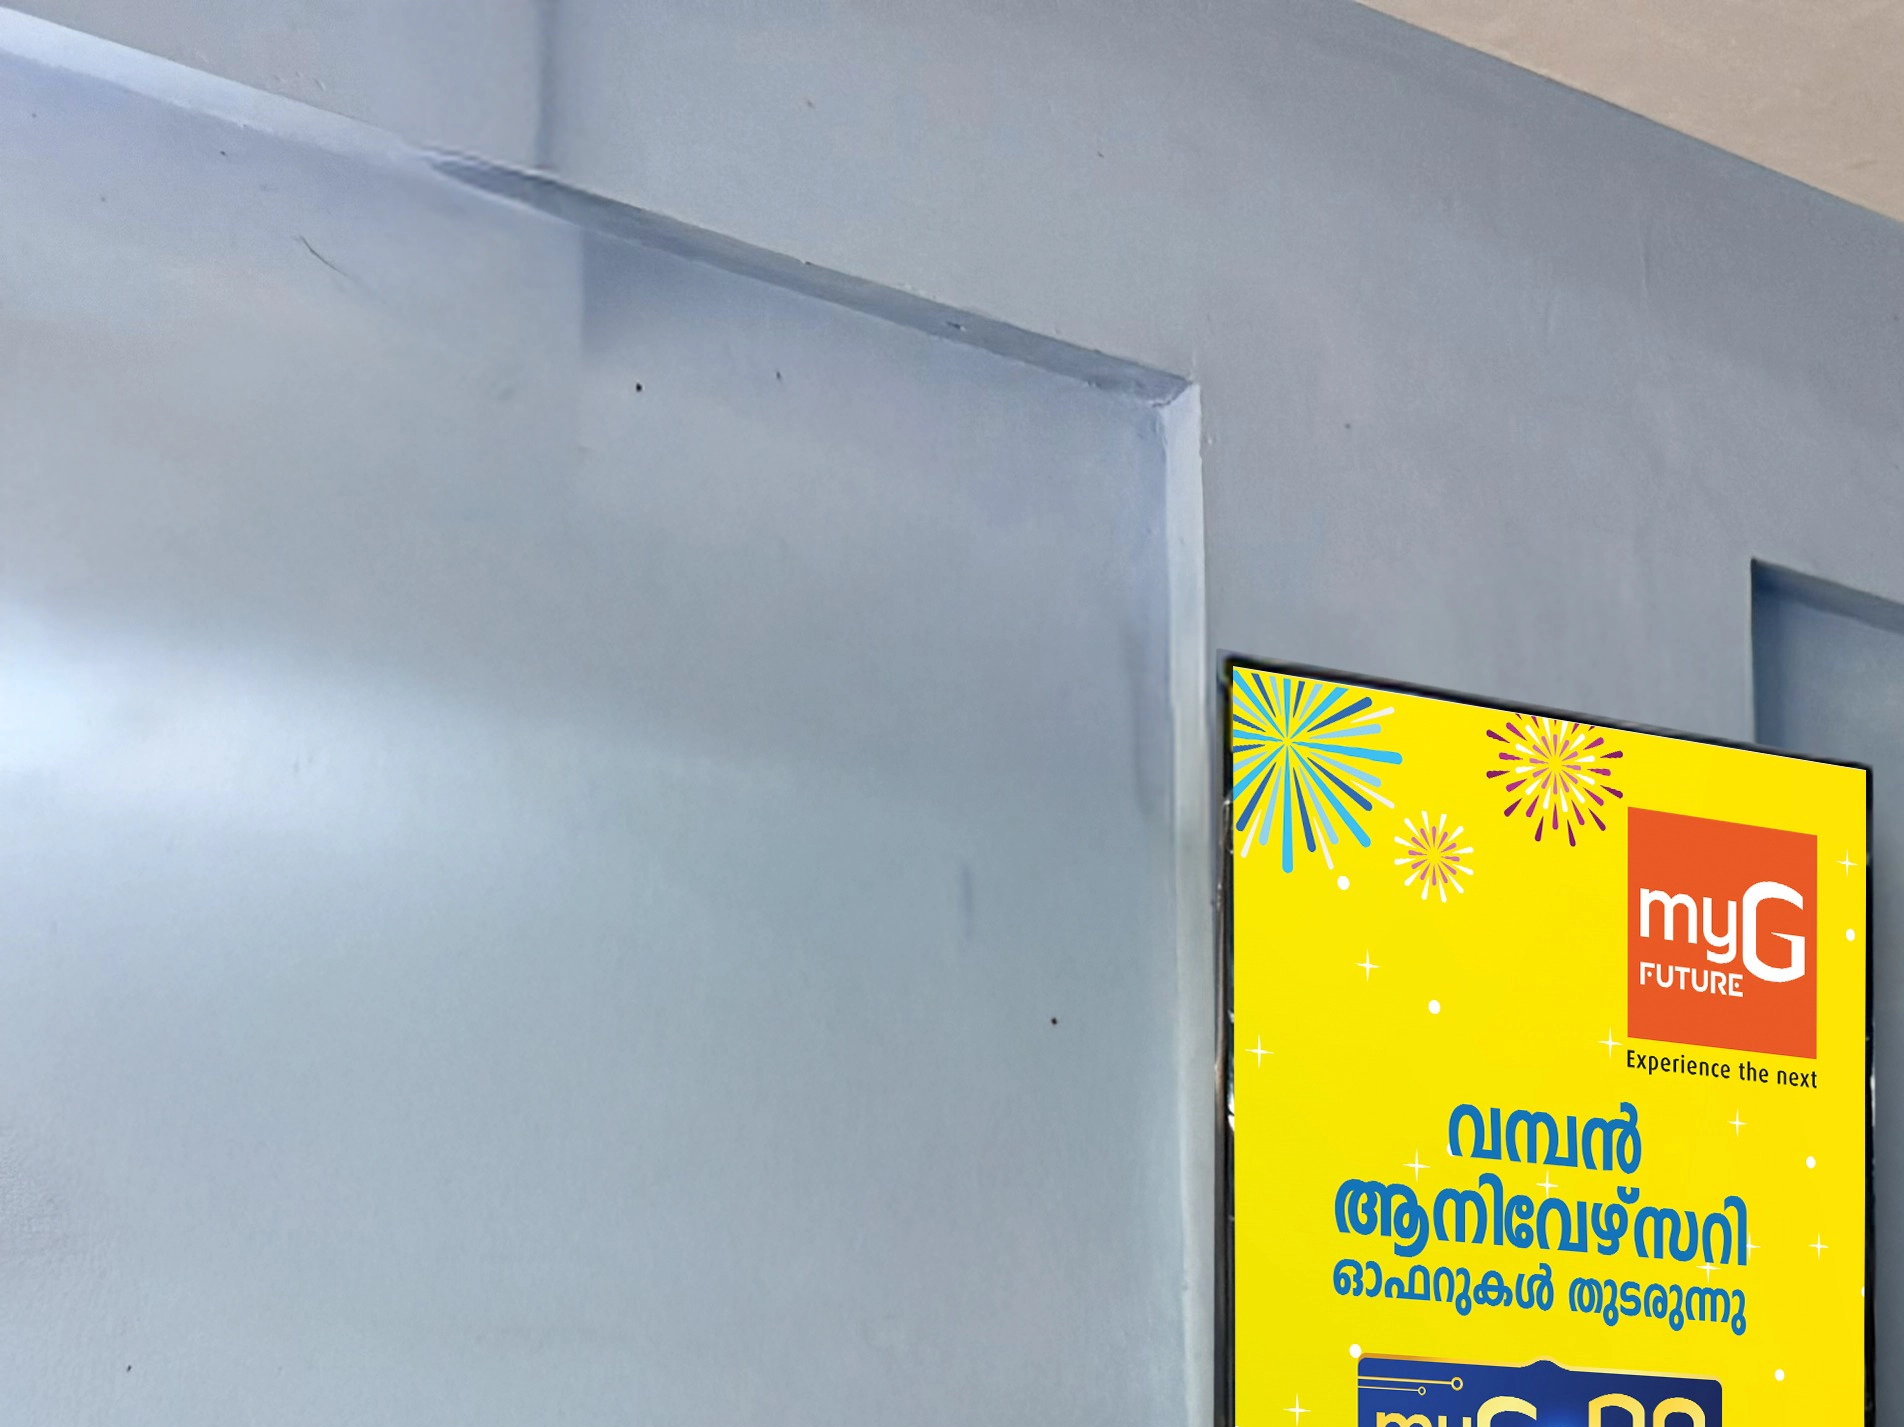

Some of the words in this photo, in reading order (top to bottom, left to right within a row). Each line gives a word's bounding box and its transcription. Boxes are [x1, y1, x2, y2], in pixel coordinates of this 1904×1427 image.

[1640, 882, 1805, 982] myG
[1640, 961, 1743, 998] FUTURE
[1627, 1049, 1731, 1079] Experience
[1739, 1061, 1769, 1083] the
[1777, 1070, 1817, 1088] next
[1448, 1102, 1642, 1174] വമ്പൻ
[1333, 1258, 1554, 1316] ഓഫറുകൾ
[1569, 1276, 1747, 1336] തുടരുന്നു
